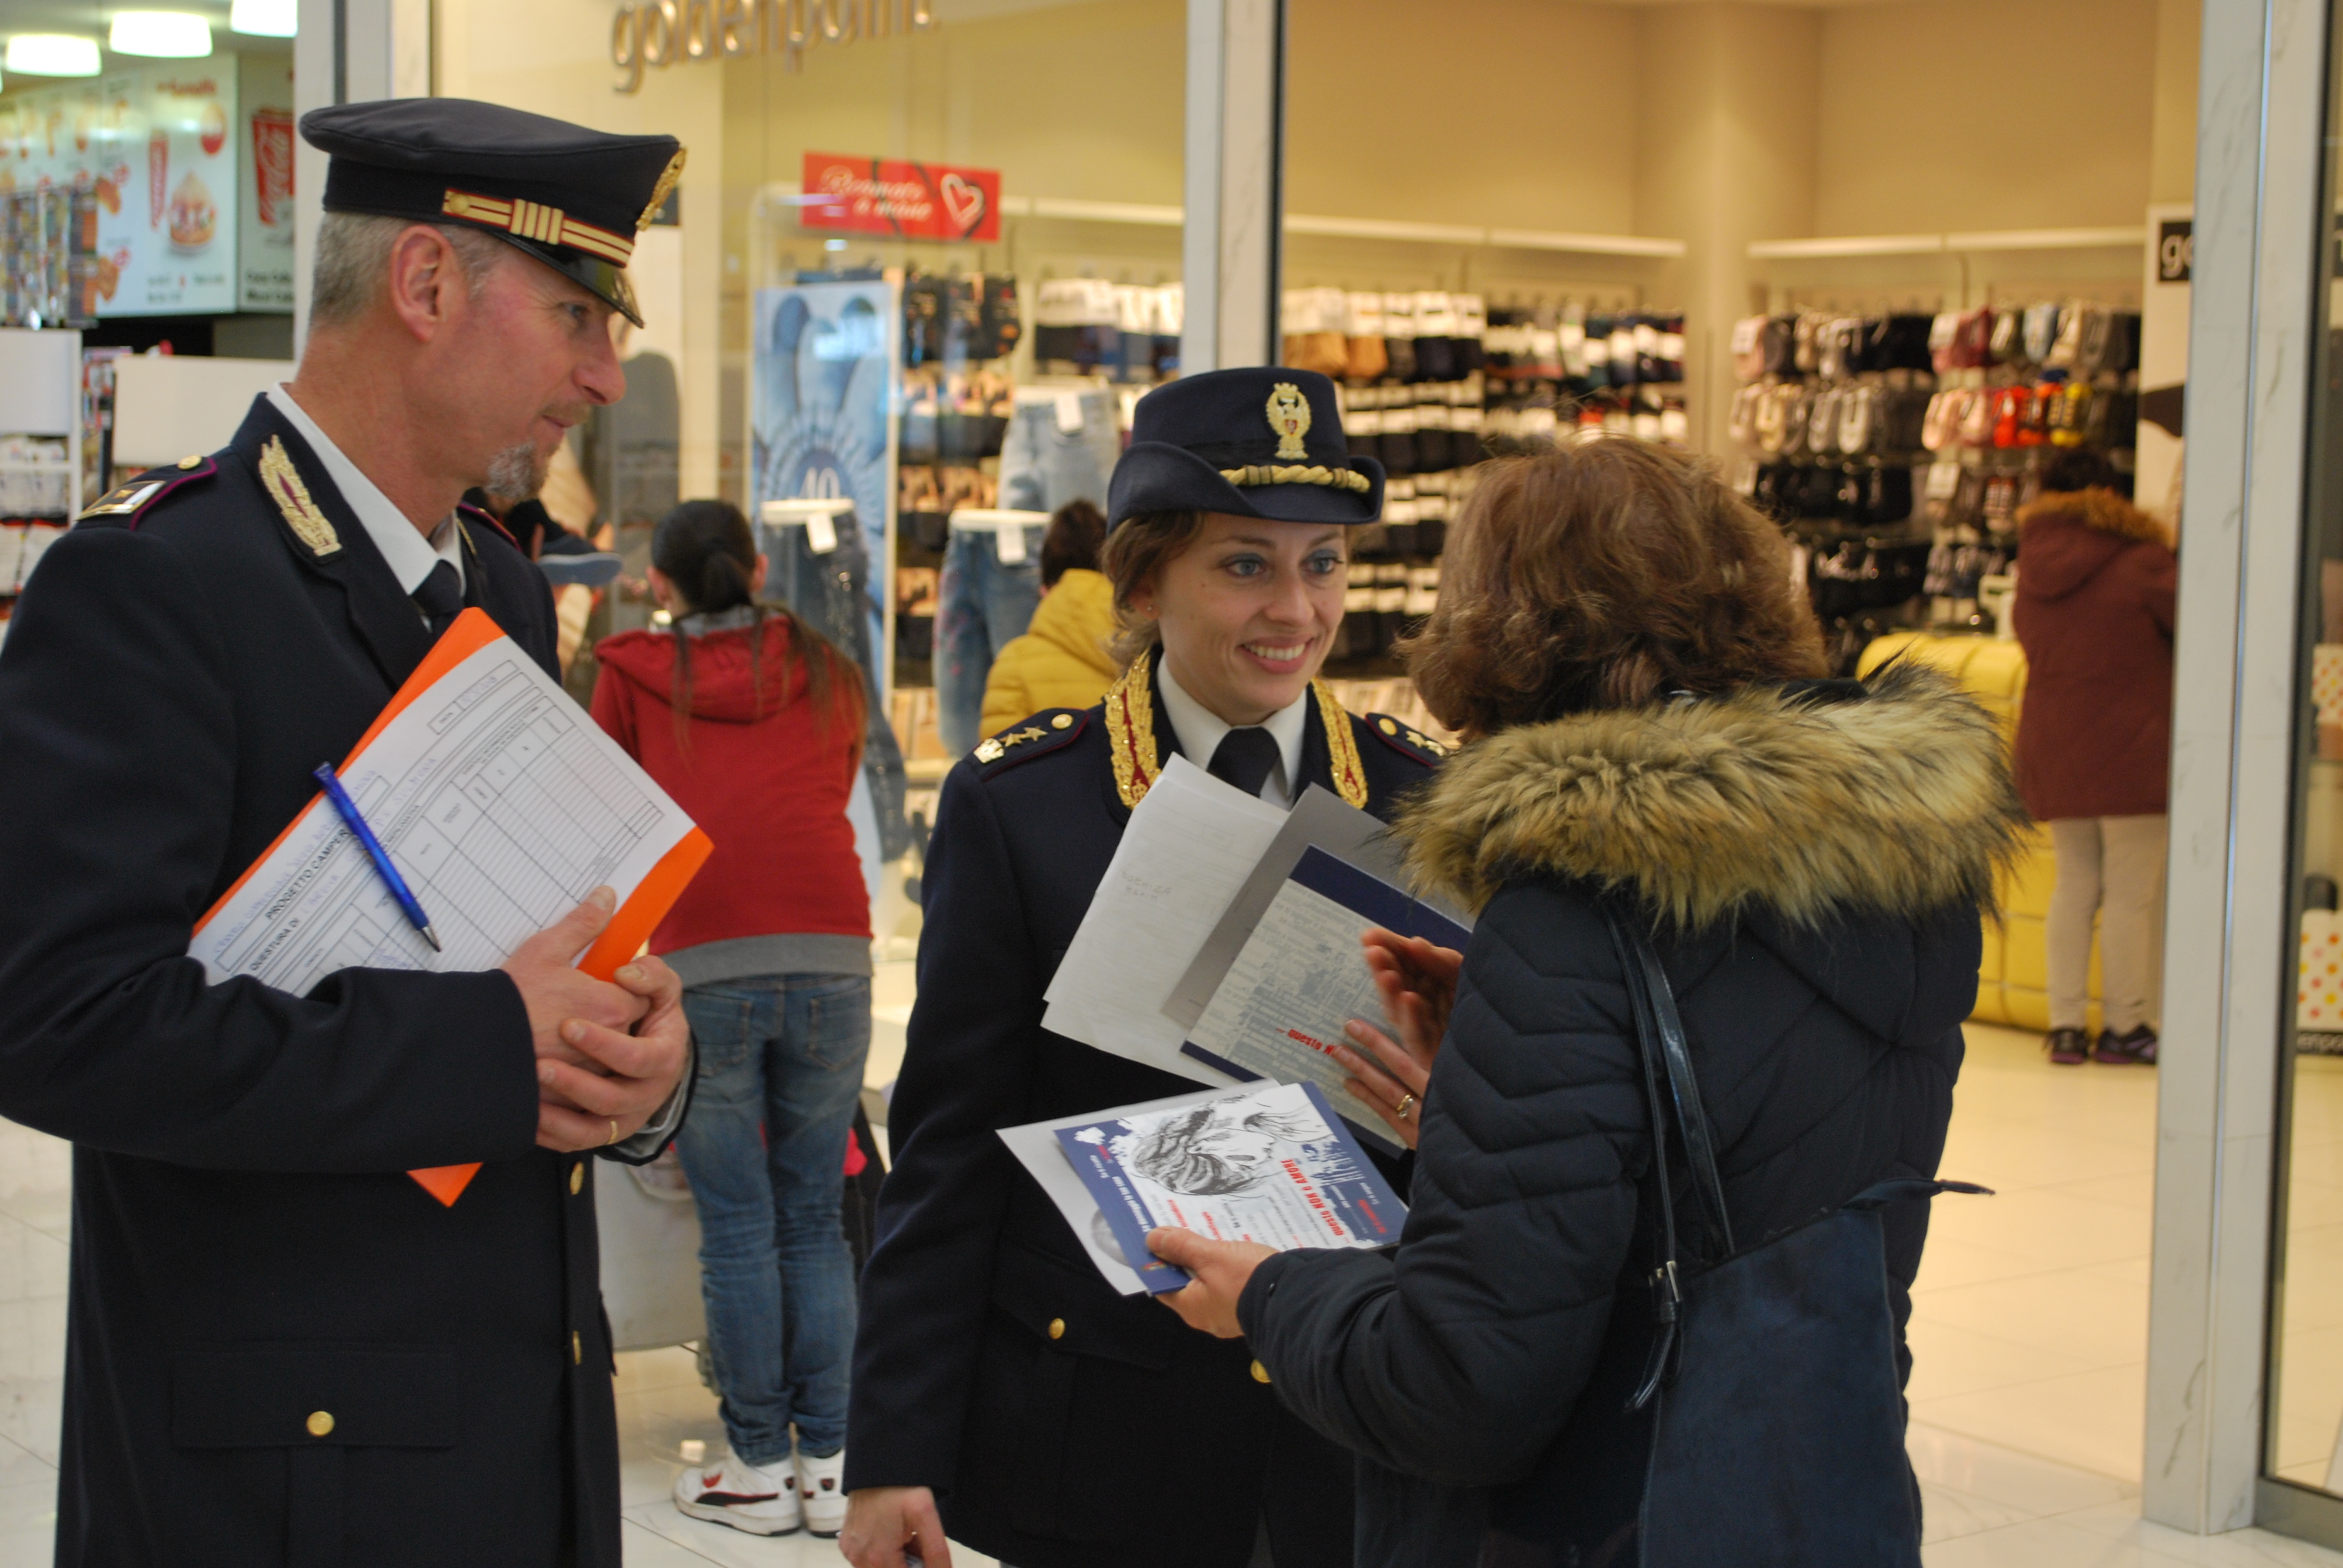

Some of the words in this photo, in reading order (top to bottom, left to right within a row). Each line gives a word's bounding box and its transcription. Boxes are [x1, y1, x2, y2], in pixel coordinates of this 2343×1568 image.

[264, 867, 313, 921] PROGETTO
[309, 826, 349, 870] CAMPER
[248, 926, 291, 972] QUESTURA
[288, 916, 300, 928] DI
[1286, 1025, 1324, 1053] questo
[1279, 1158, 1308, 1184] AMORE
[1304, 1192, 1325, 1209] NON
[1319, 1210, 1345, 1236] questo
